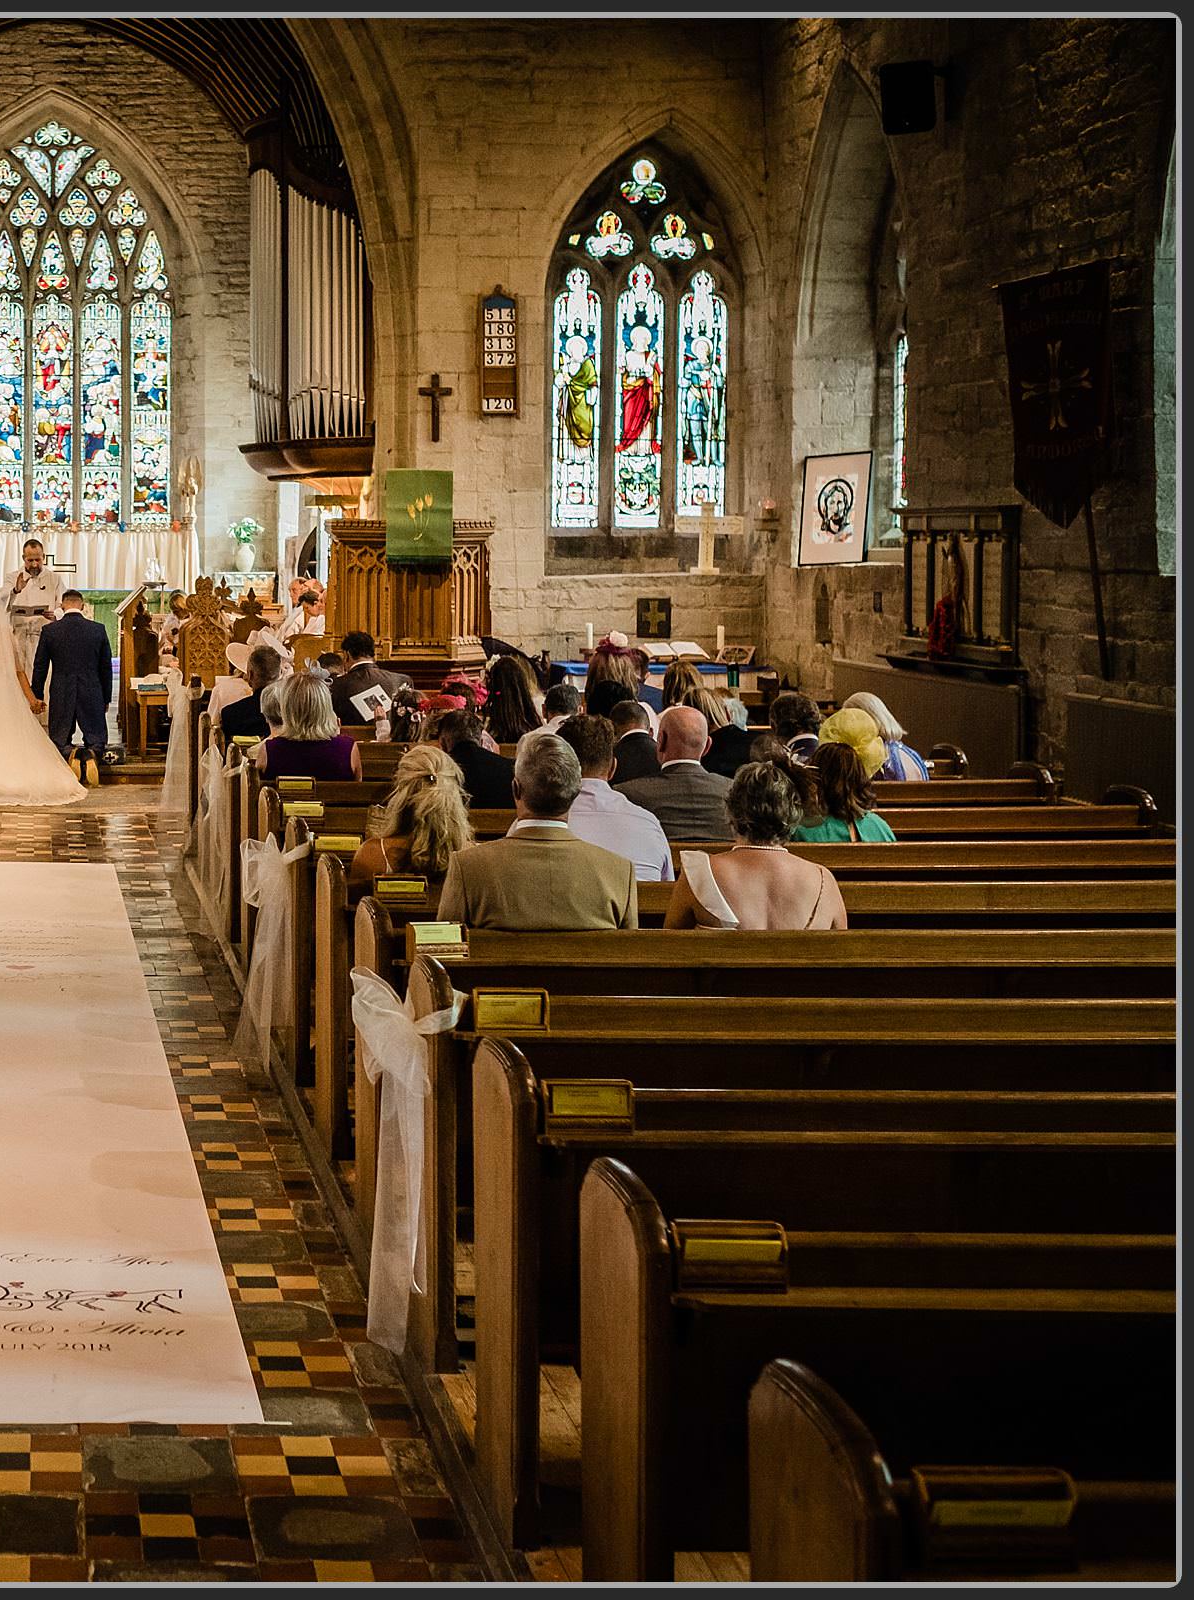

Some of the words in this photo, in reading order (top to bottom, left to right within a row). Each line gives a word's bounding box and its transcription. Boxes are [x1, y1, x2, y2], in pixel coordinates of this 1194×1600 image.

[486, 309, 514, 320] 514
[487, 323, 515, 335] 180
[486, 338, 514, 350] 313
[486, 353, 515, 365] 372
[485, 399, 512, 410] 120
[0, 1252, 78, 1264] Ever
[86, 1253, 174, 1267] After
[63, 1320, 186, 1337] Alicia
[57, 1343, 112, 1352] 2018
